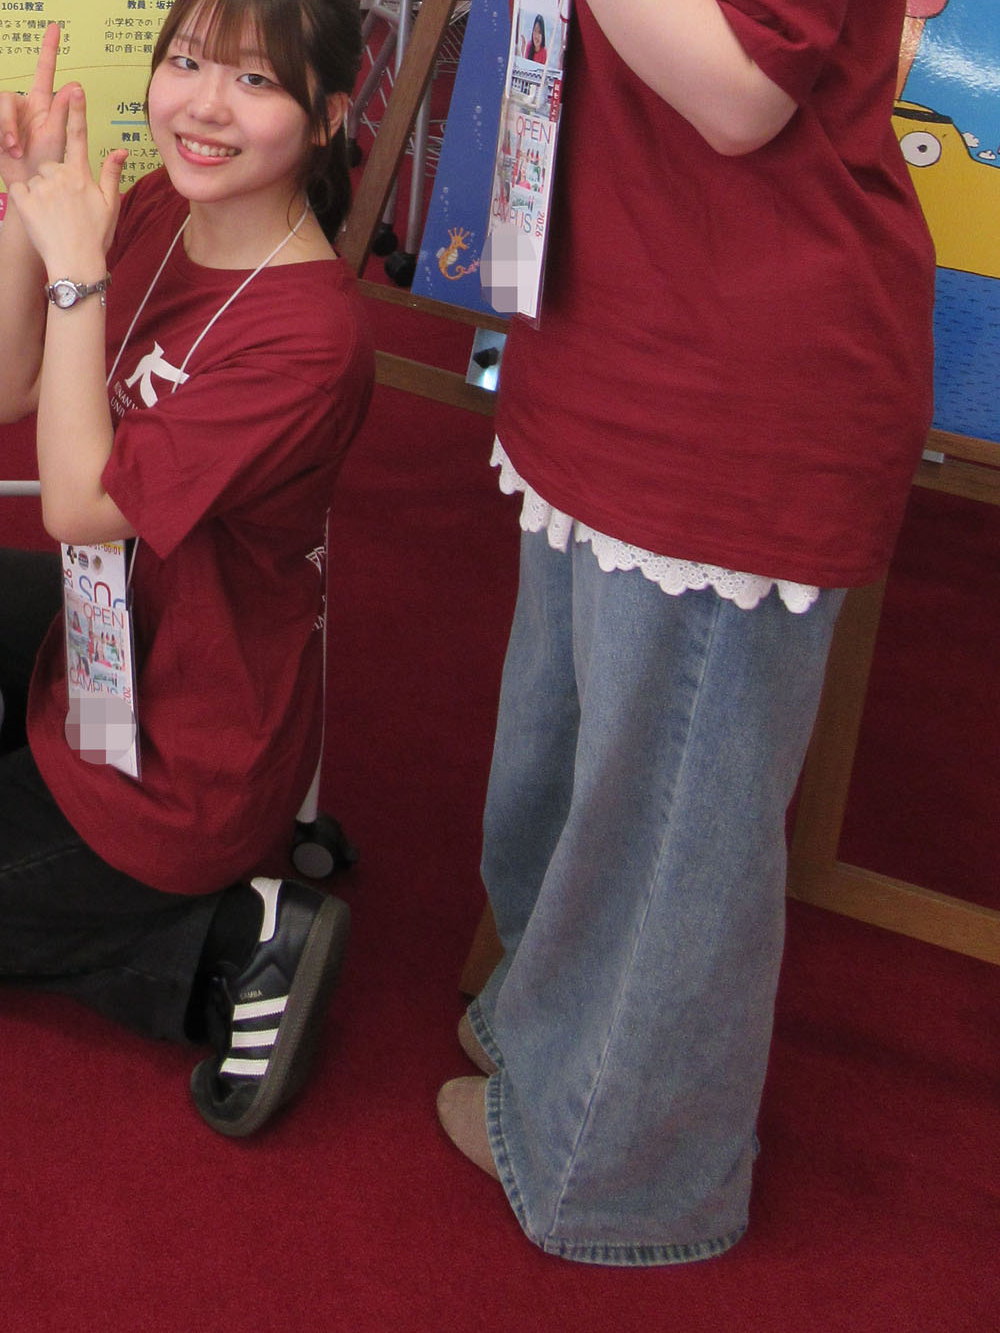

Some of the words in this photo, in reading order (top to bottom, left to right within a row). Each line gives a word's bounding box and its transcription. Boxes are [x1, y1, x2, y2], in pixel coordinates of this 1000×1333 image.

[105, 18, 166, 27] 小学校での「
[121, 132, 154, 142] 教員：
[516, 116, 552, 144] OPEN
[535, 210, 545, 238] 2026
[83, 602, 125, 630] OPEN
